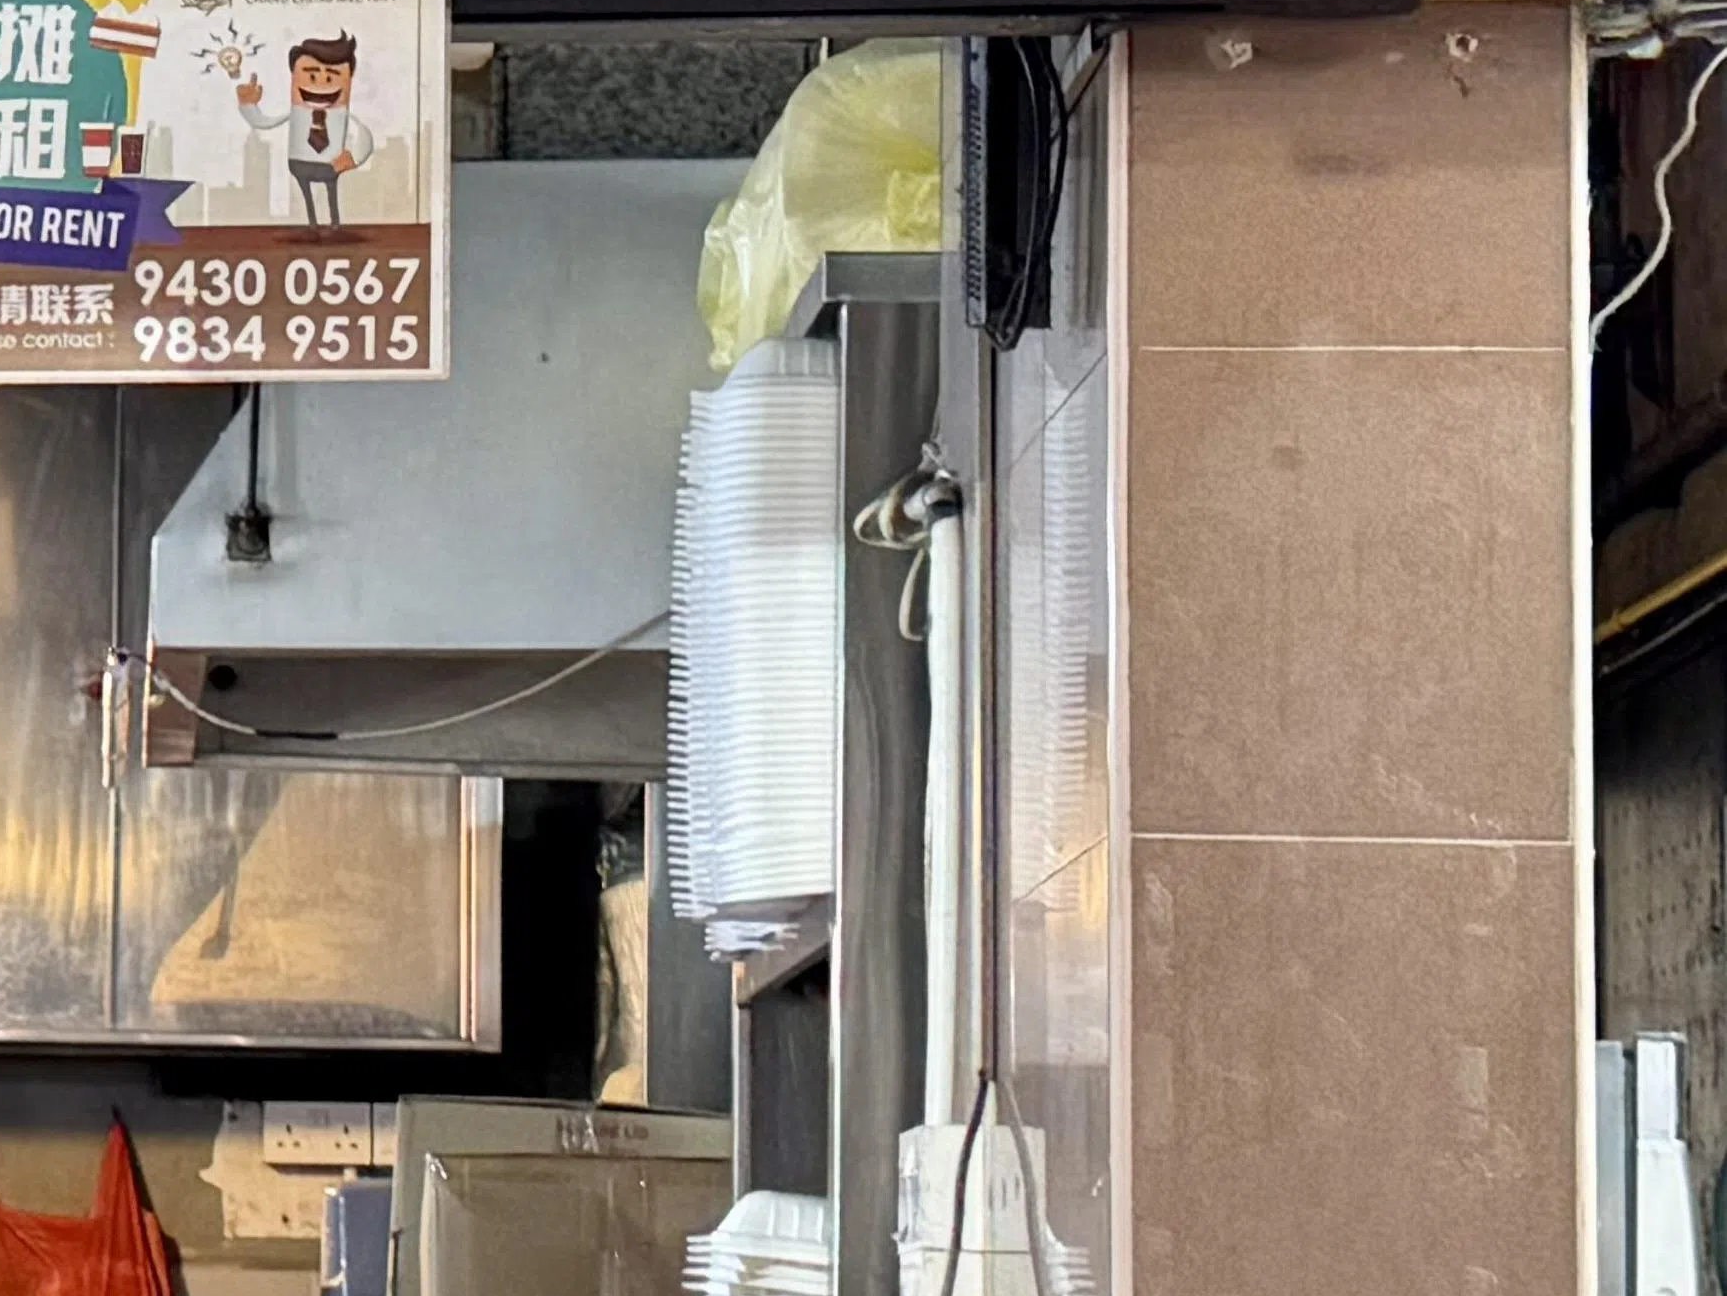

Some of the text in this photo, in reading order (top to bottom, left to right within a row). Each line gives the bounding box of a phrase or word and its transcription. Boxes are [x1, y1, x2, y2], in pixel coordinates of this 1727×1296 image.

[41, 205, 125, 249] RENT
[134, 258, 420, 304] 9430 0567
[134, 315, 419, 362] 9834 9515
